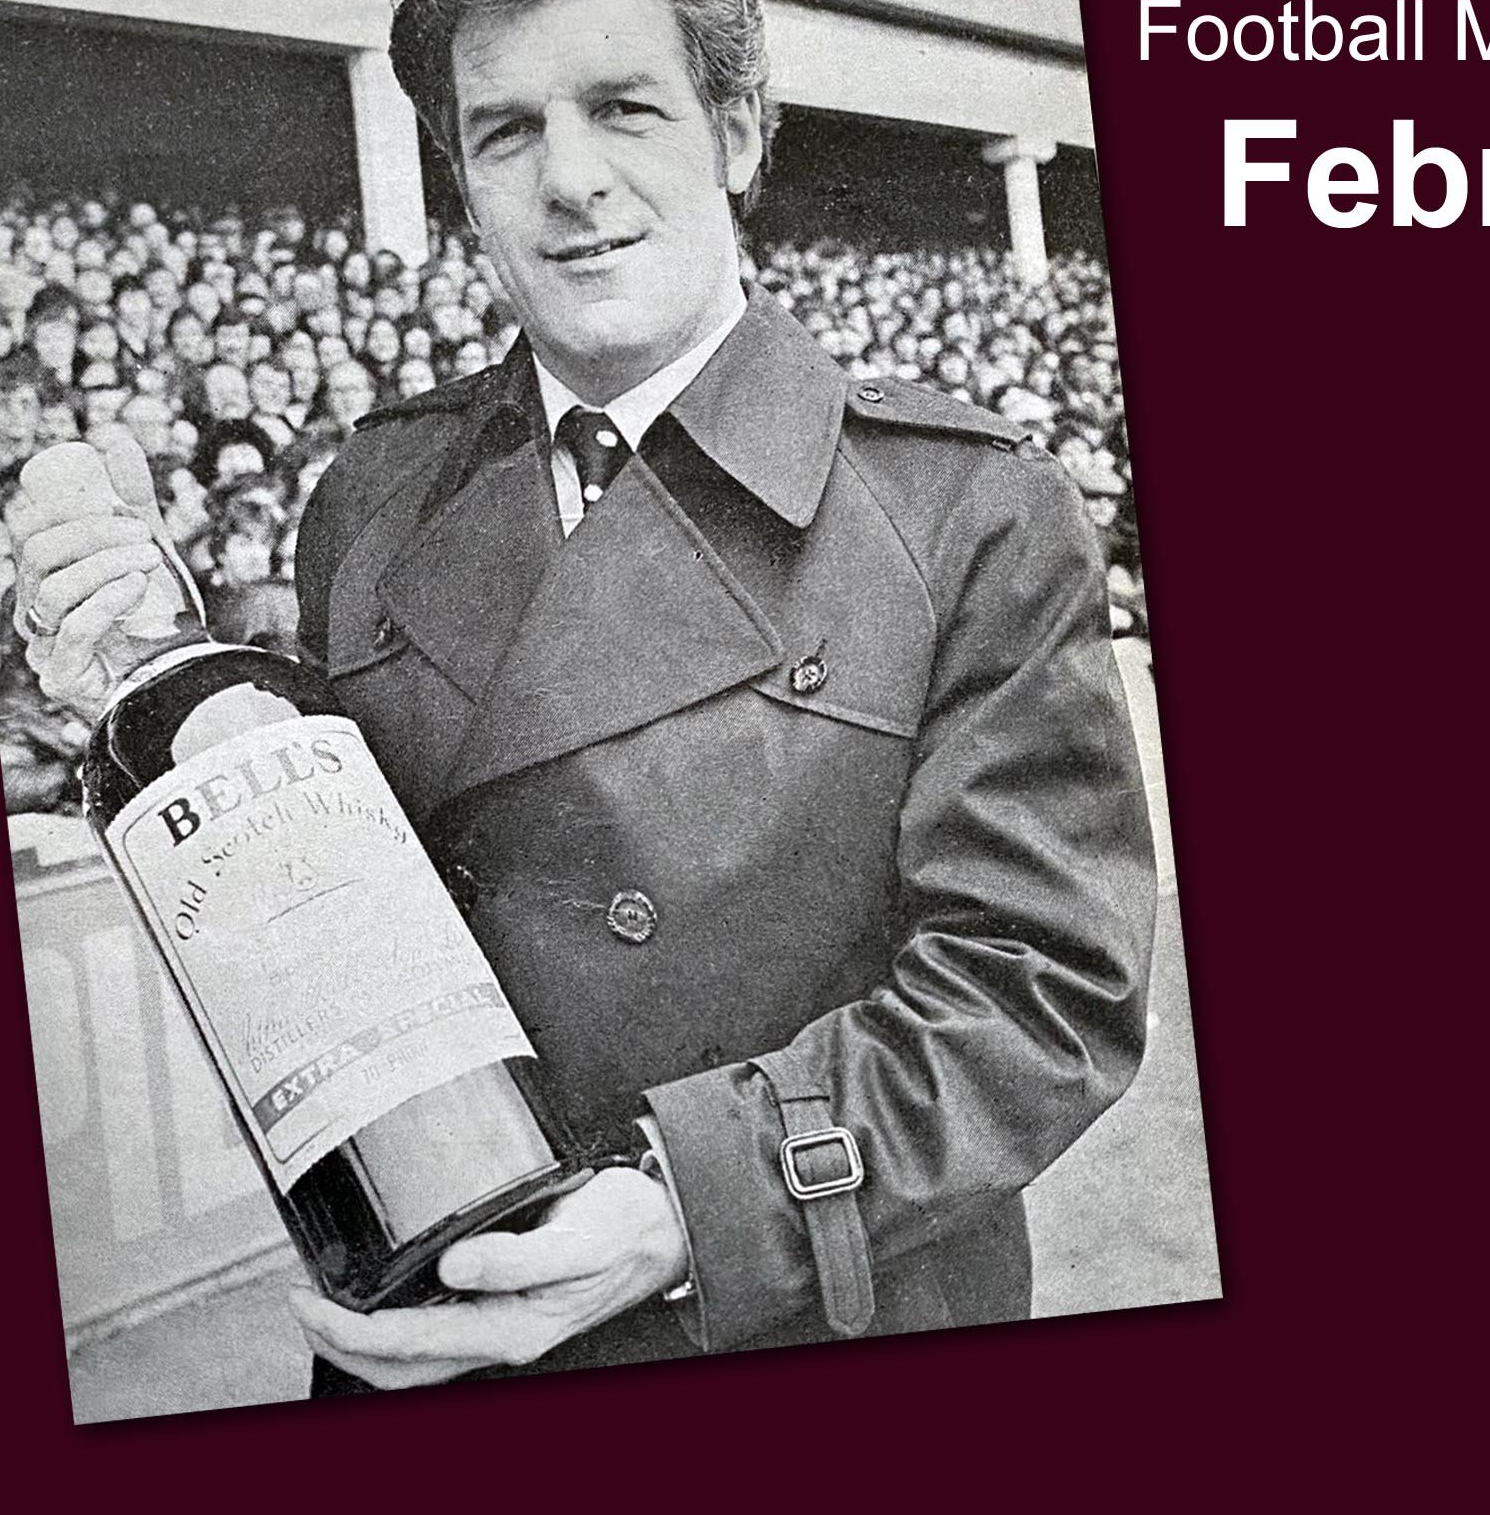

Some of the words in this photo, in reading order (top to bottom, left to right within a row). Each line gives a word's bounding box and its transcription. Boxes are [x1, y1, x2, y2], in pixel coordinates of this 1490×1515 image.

[156, 738, 344, 847] BELL'S
[173, 880, 207, 941] Old
[202, 801, 293, 876] Scotch
[305, 789, 409, 845] Whisky
